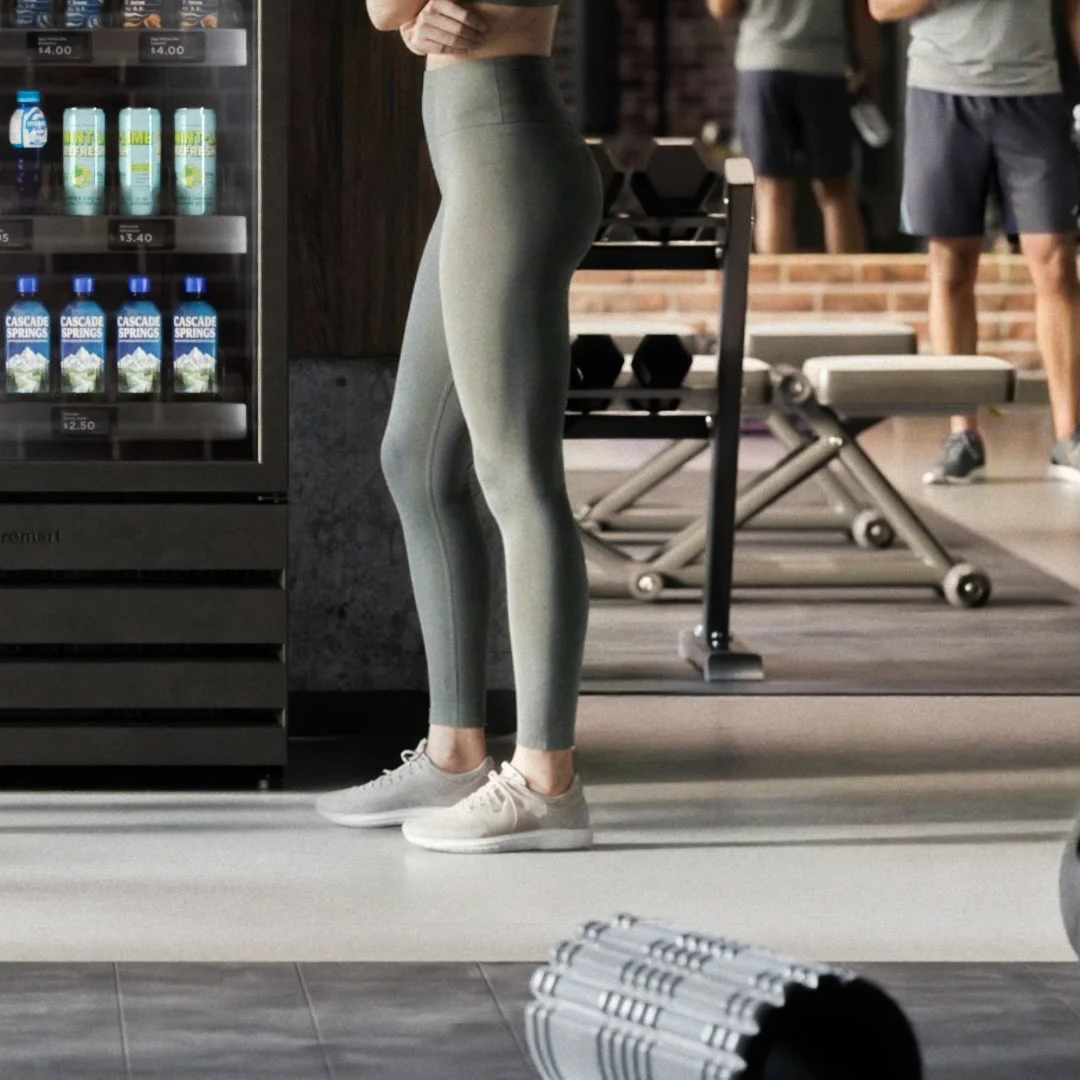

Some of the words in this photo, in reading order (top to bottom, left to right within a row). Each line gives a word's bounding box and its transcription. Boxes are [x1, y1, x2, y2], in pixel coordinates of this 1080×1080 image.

[38, 45, 72, 55] $4.00
[151, 45, 184, 55] $4.00
[120, 233, 153, 243] $3.40
[5, 315, 49, 327] CASCADE
[60, 315, 104, 327] CASCADE
[117, 315, 160, 327] CASCADE
[173, 315, 217, 327] CASCADE
[6, 327, 48, 339] SPRINGS
[61, 327, 103, 339] SPRINGS
[118, 327, 160, 339] SPRINGS
[174, 327, 216, 339] SPRINGS
[63, 421, 96, 431] $2.50
